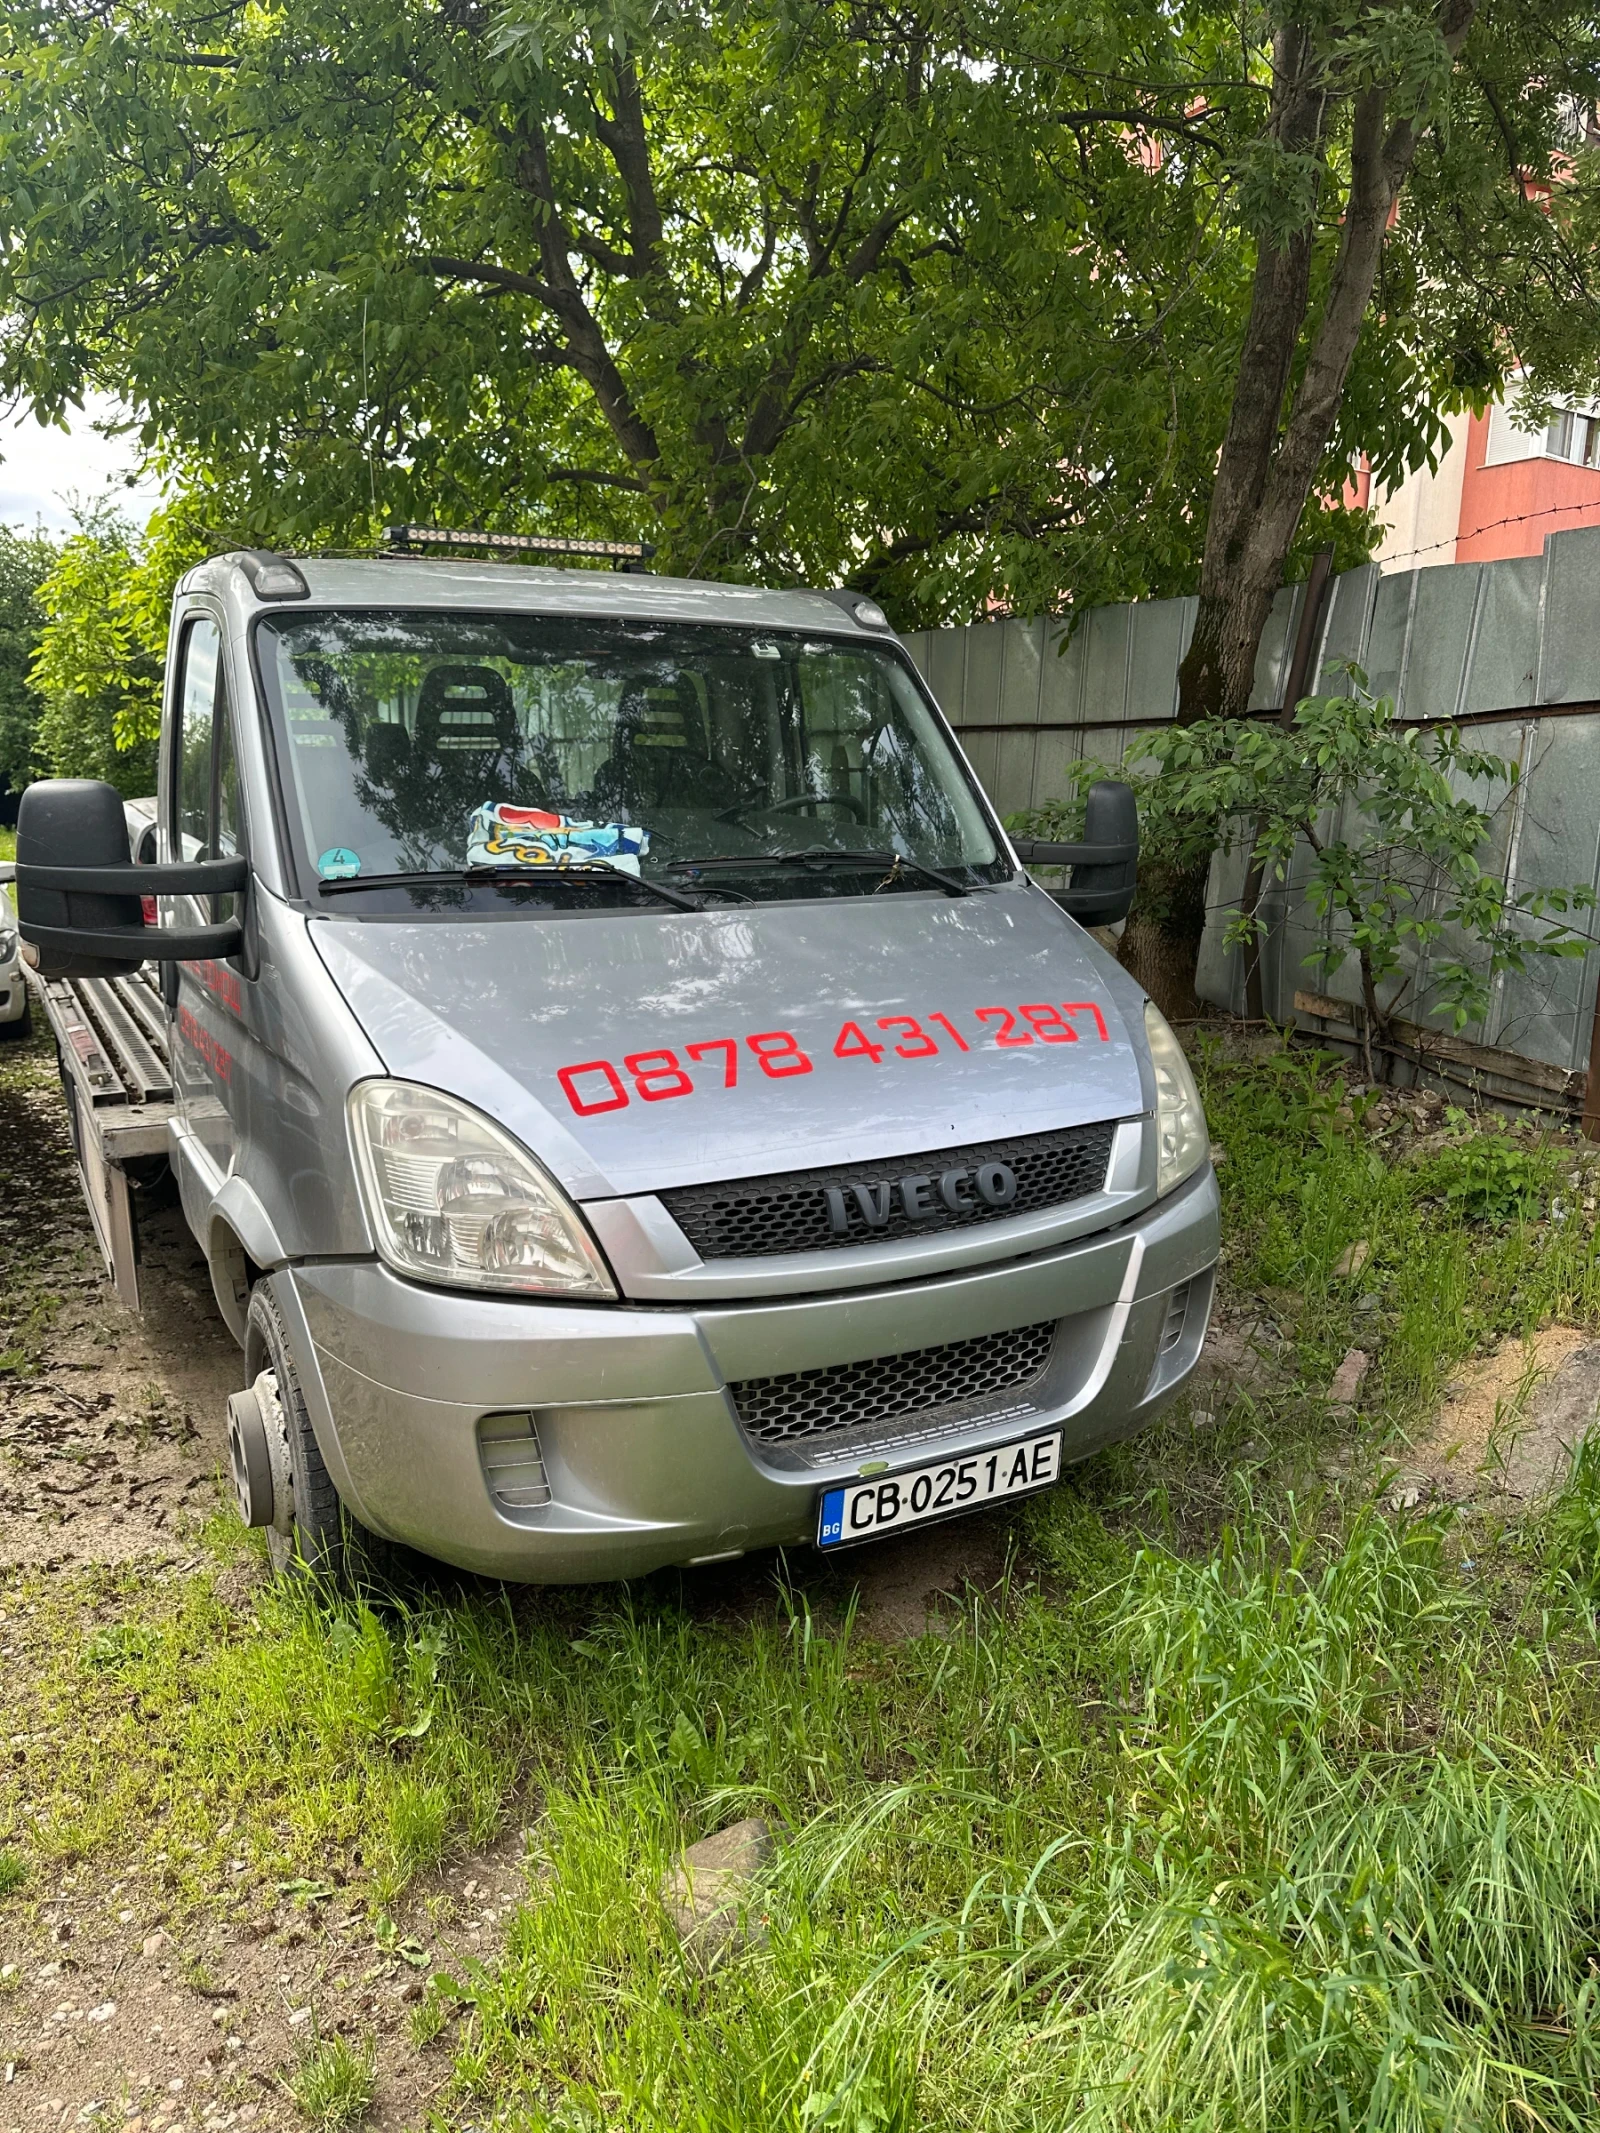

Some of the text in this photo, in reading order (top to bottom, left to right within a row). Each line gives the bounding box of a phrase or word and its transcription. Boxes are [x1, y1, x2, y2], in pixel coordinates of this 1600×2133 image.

[332, 849, 346, 864] 4
[557, 1001, 1111, 1117] 0878 431 287
[823, 1162, 1018, 1232] IVECO
[822, 1522, 840, 1537] BG
